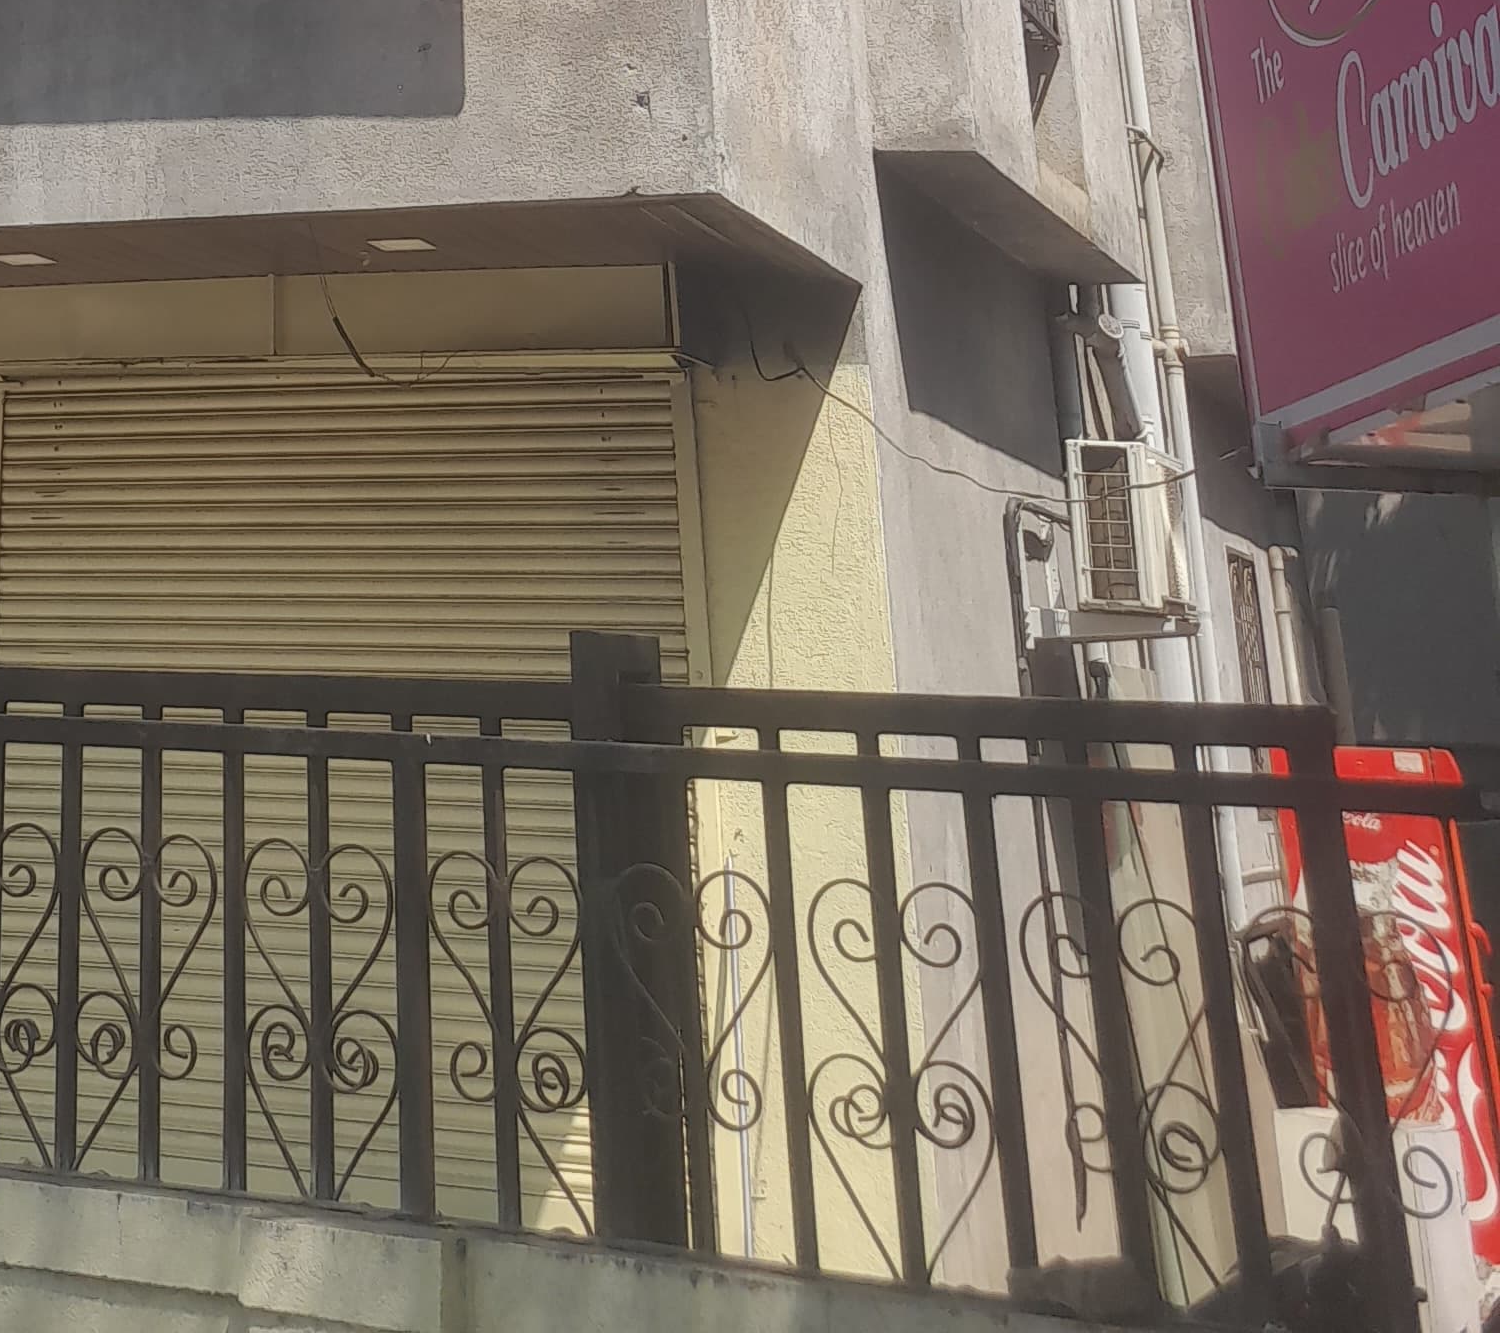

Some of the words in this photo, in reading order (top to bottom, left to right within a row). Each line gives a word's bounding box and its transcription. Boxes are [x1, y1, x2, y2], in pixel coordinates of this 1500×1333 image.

[1251, 37, 1286, 104] The
[1330, 231, 1367, 294] slice
[1369, 201, 1389, 281] of
[1389, 180, 1462, 260] heaven
